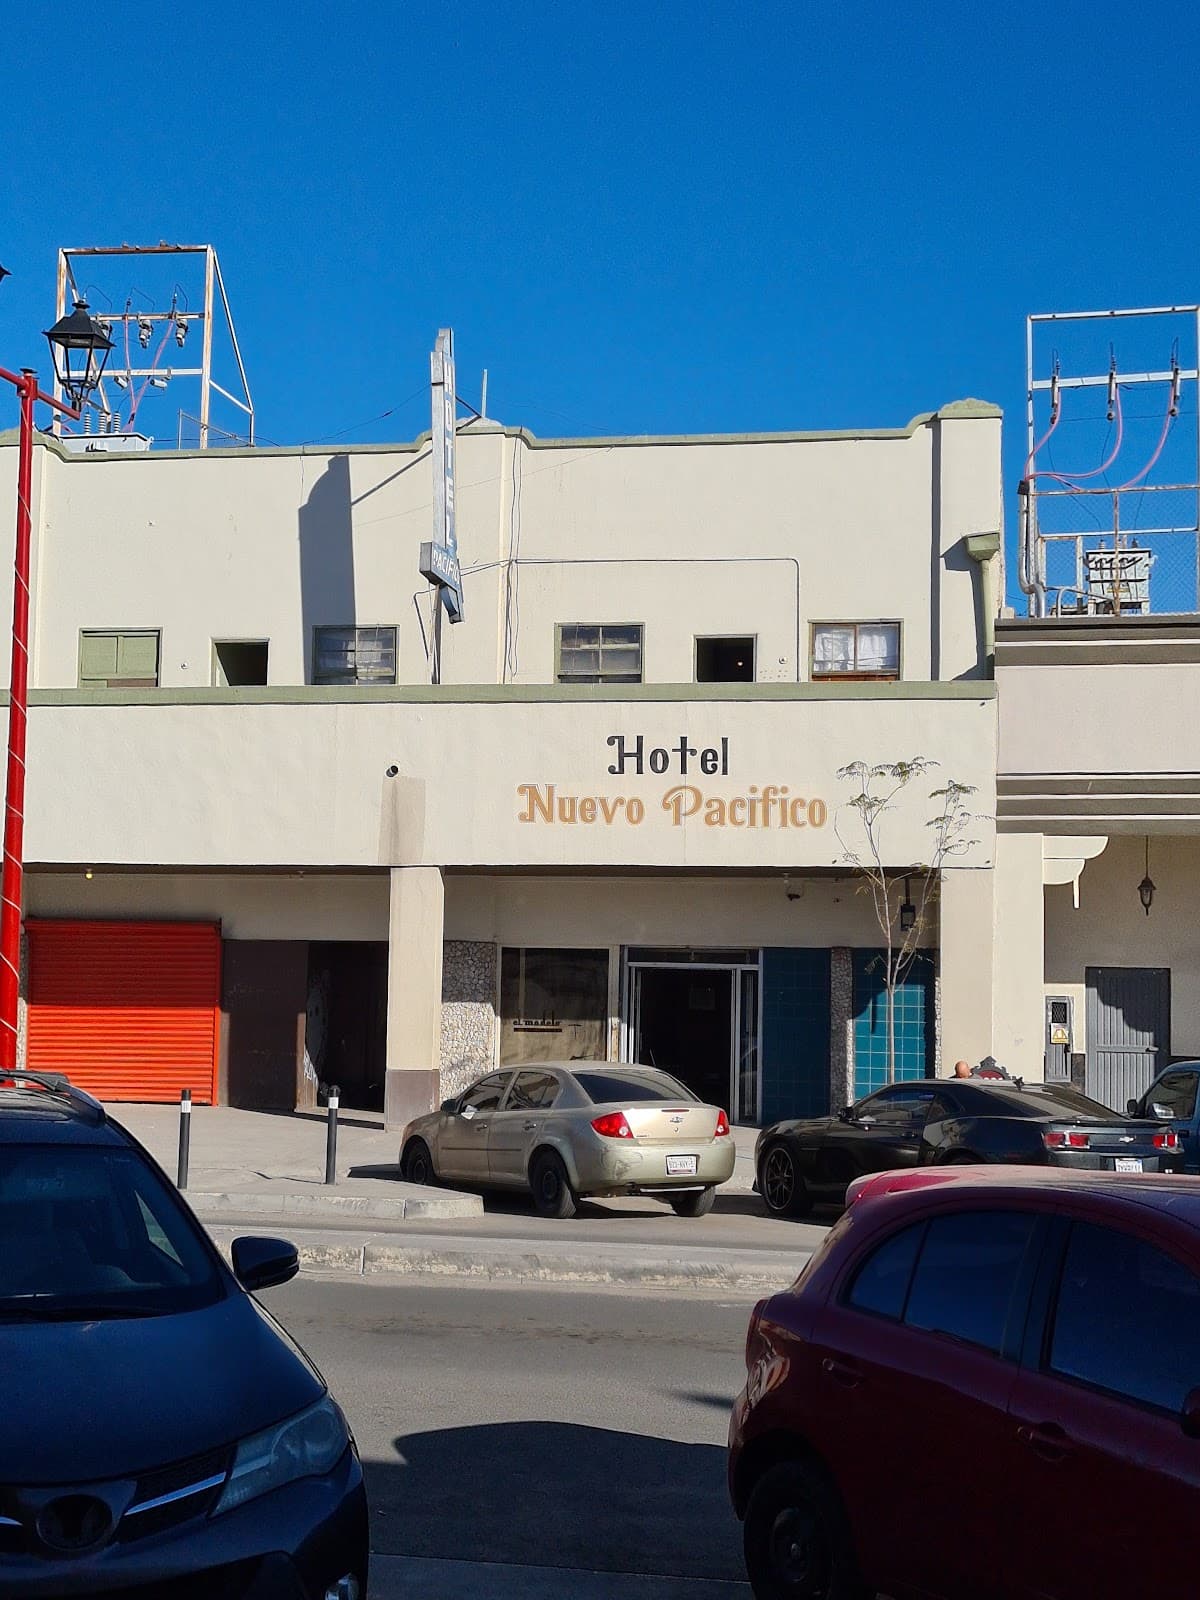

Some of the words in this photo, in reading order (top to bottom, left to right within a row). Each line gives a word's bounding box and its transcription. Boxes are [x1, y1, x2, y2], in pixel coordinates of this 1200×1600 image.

[444, 361, 455, 546] HOTEL
[606, 735, 729, 775] Hotel
[516, 783, 645, 825] Nuevo
[661, 784, 828, 828] Pacifico
